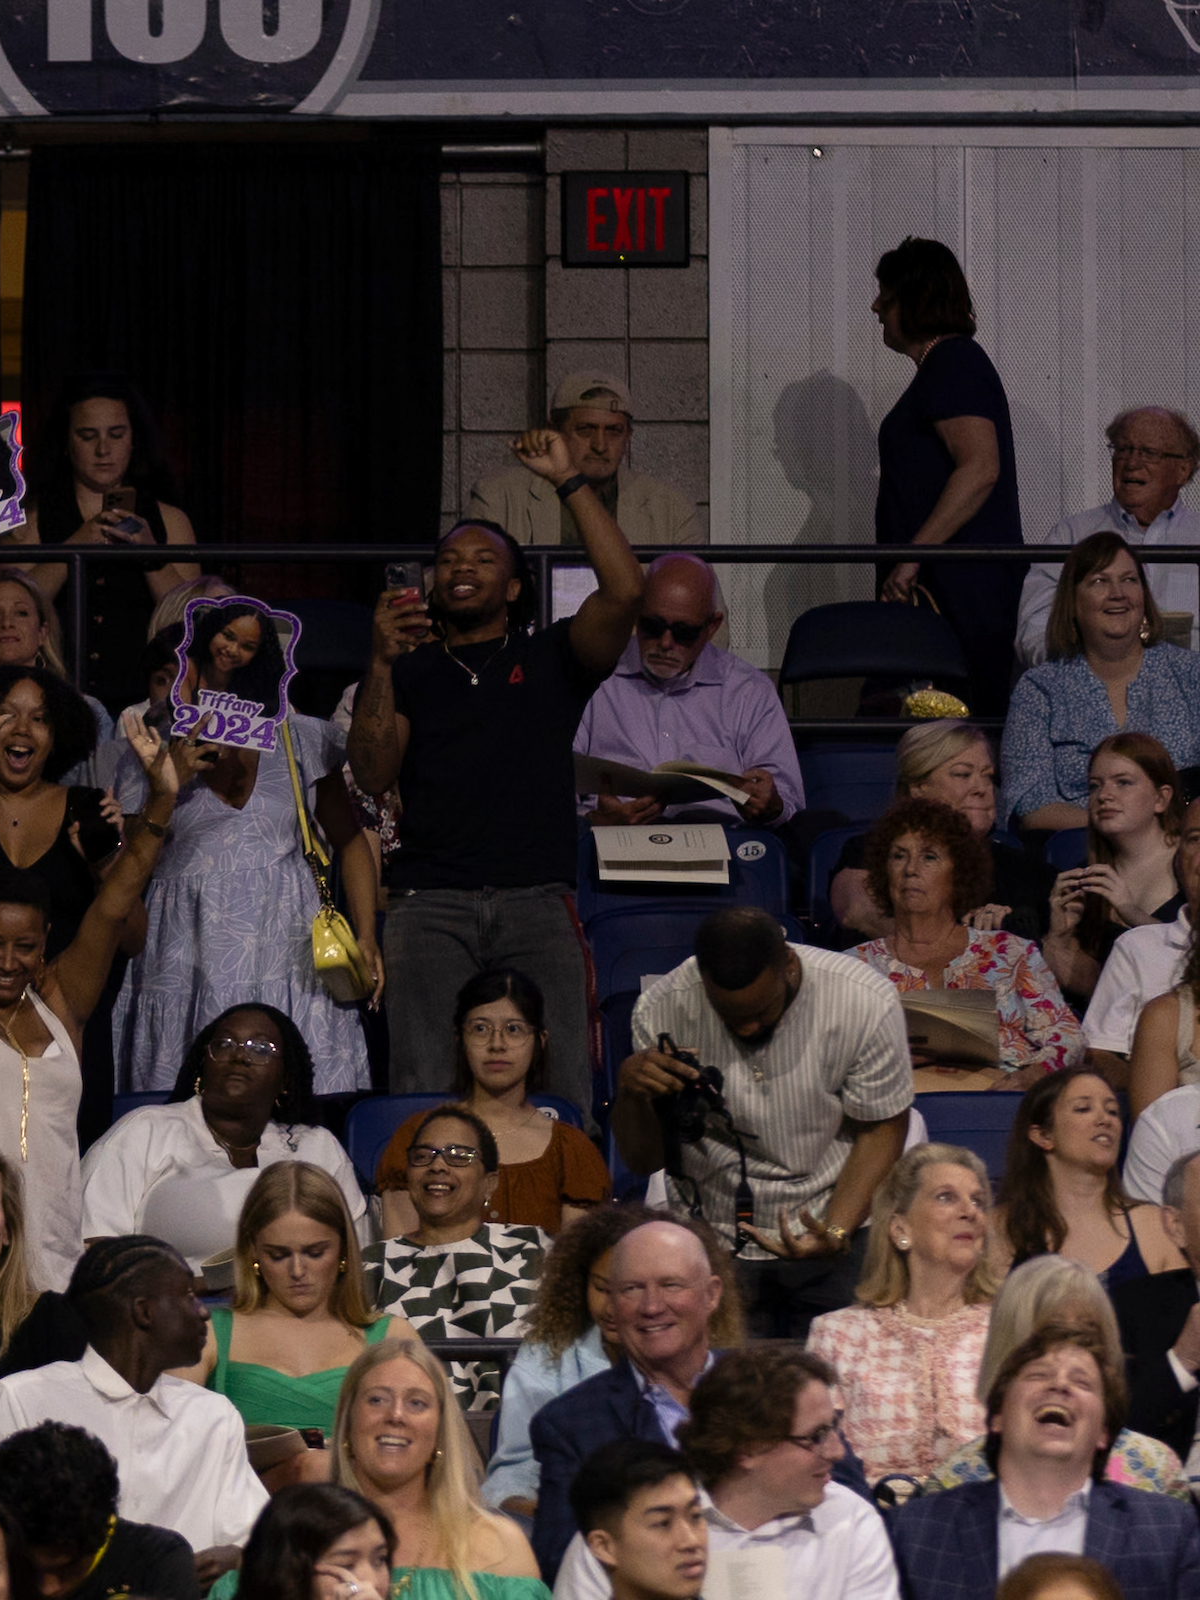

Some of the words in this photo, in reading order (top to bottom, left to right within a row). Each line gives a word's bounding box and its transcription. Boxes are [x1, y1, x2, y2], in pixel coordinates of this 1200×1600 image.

[586, 186, 672, 252] EXIT
[199, 690, 263, 719] Tiffany
[172, 705, 276, 750] 2024
[743, 845, 760, 857] 15
